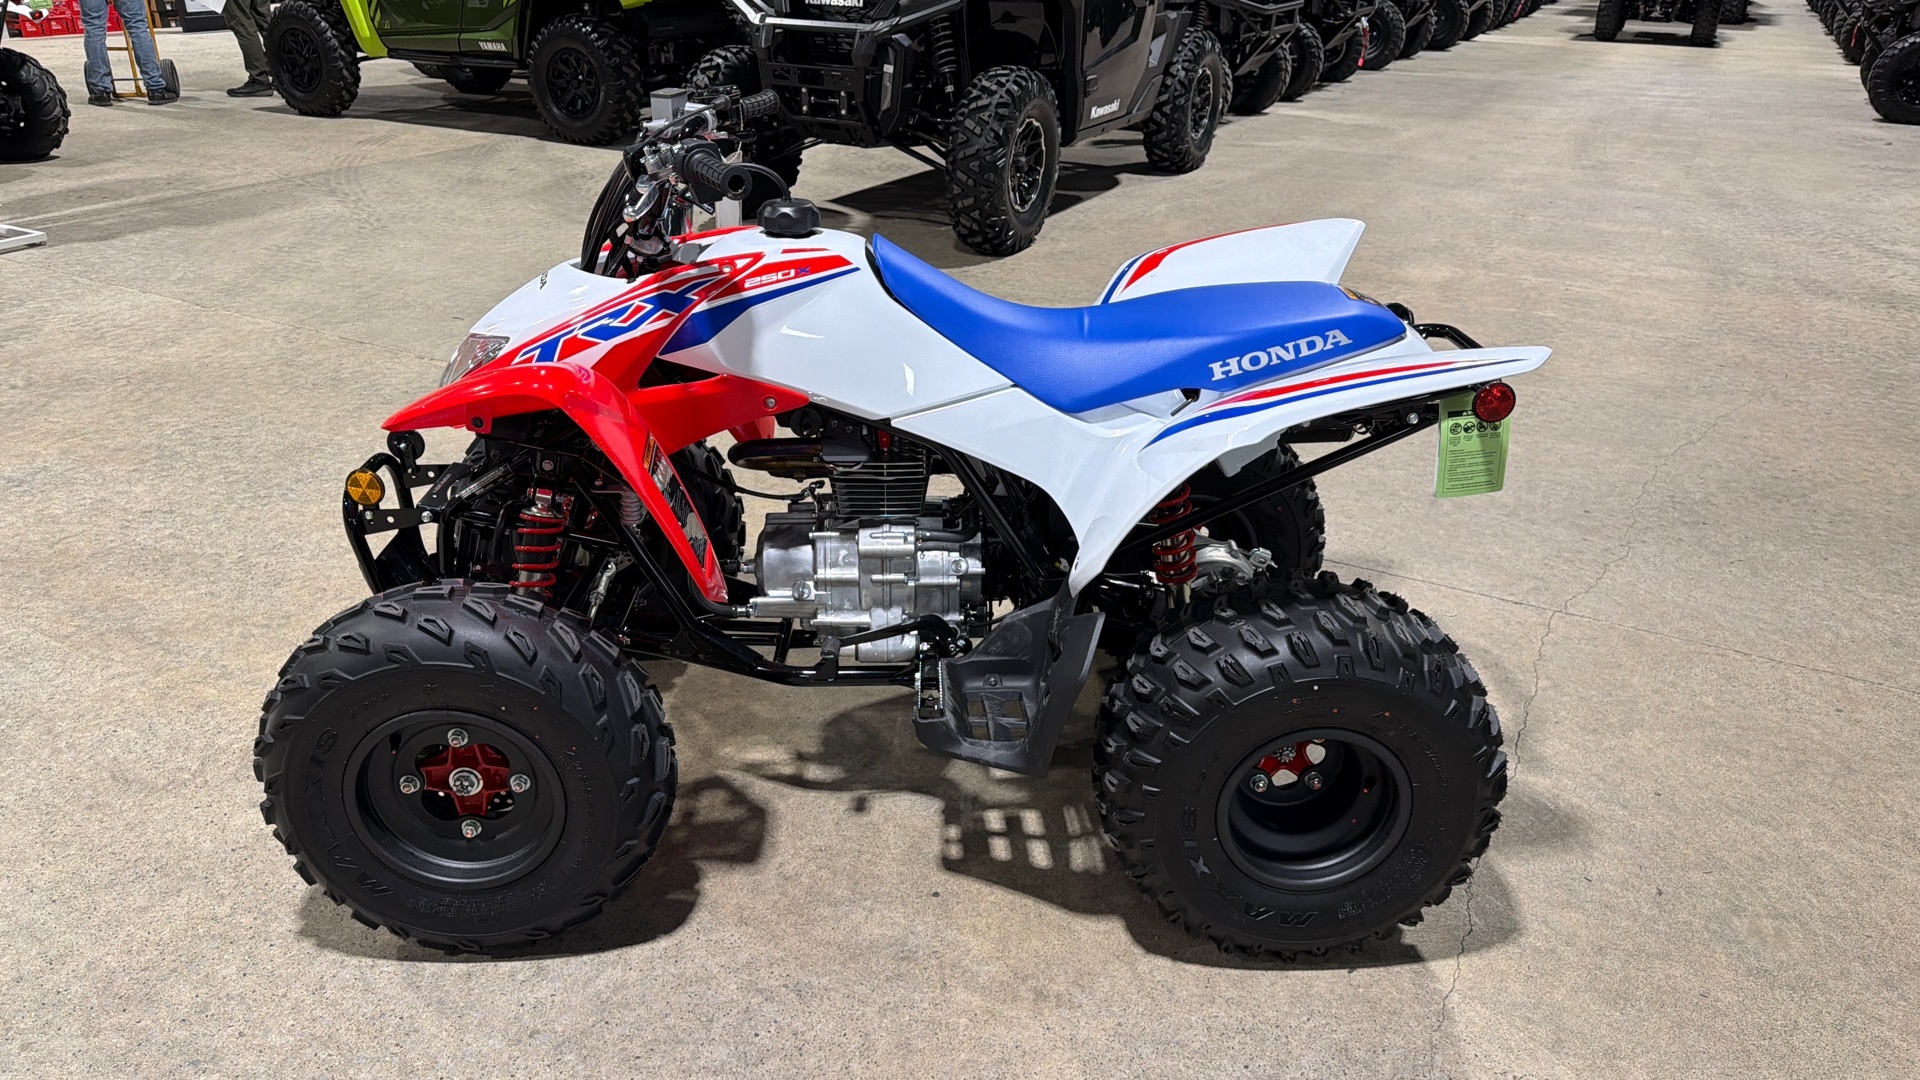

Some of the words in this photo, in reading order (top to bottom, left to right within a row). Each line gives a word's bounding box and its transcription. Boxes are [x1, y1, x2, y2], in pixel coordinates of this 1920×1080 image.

[478, 41, 507, 51] YAMAHA
[1090, 98, 1120, 119] Kawasaki
[511, 275, 722, 362] TRX
[1208, 329, 1353, 381] HONDA
